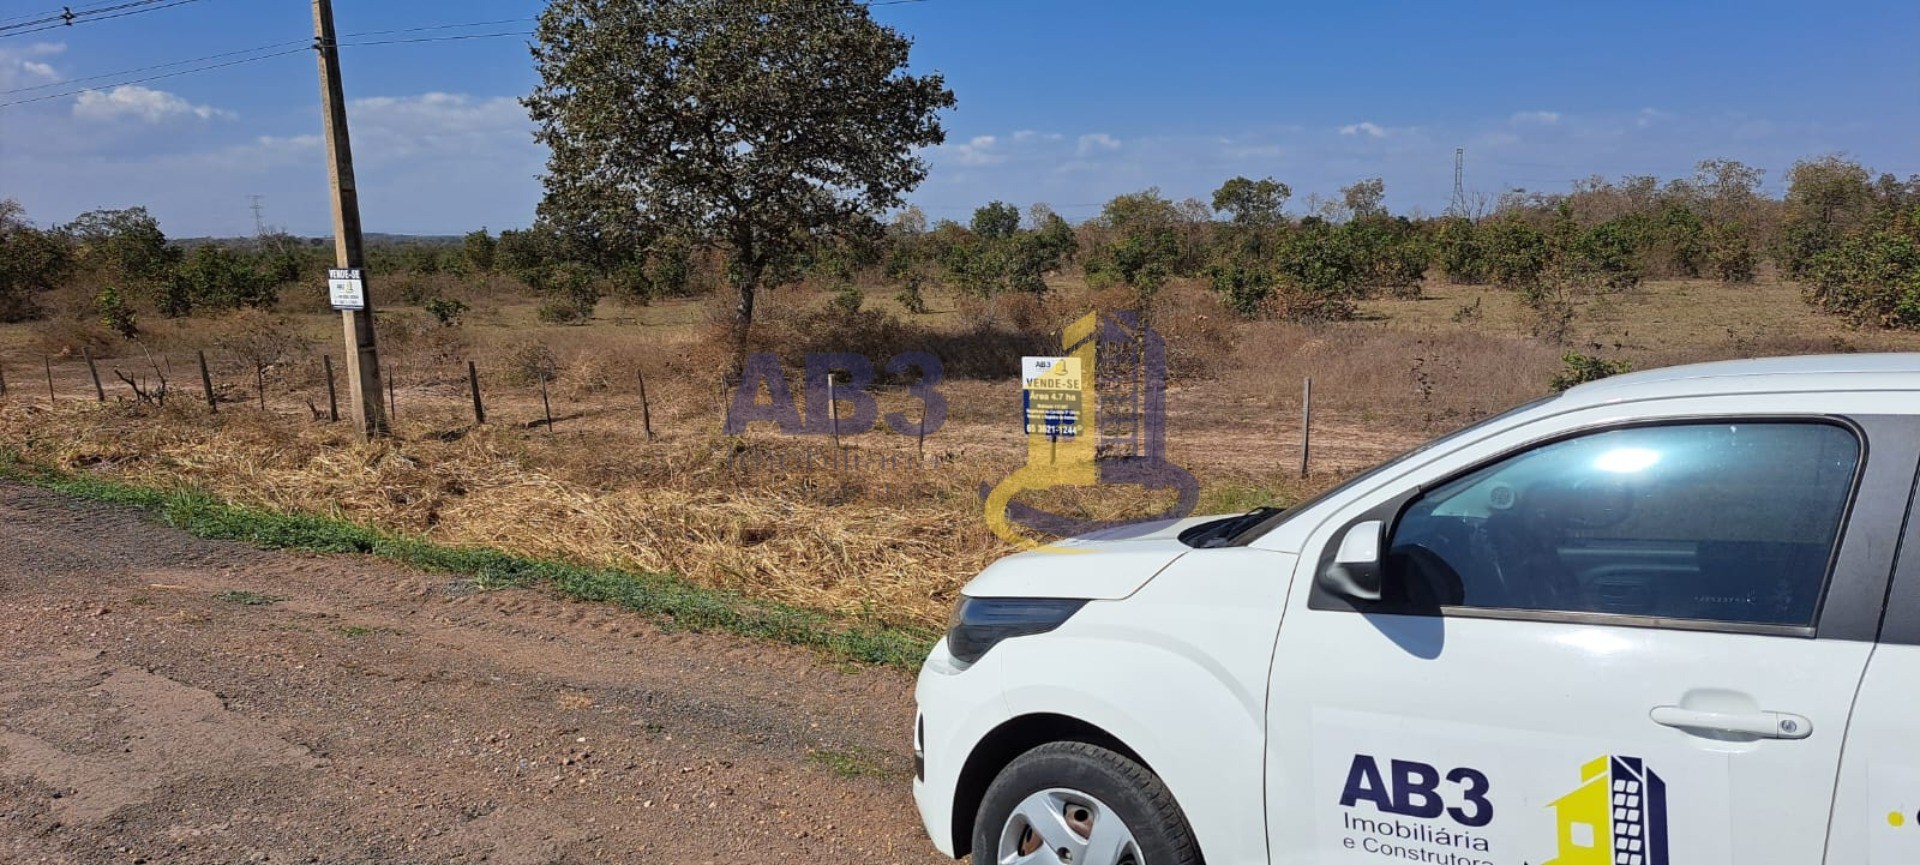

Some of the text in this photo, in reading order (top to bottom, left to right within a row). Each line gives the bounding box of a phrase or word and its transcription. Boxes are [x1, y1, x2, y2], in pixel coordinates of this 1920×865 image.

[328, 269, 360, 279] VENDE-SE
[1026, 378, 1079, 389] VENDE-SE
[1029, 391, 1050, 401] Área
[1339, 753, 1494, 828] AB3
[1344, 811, 1489, 852] Imobiliária
[1343, 837, 1356, 849] e
